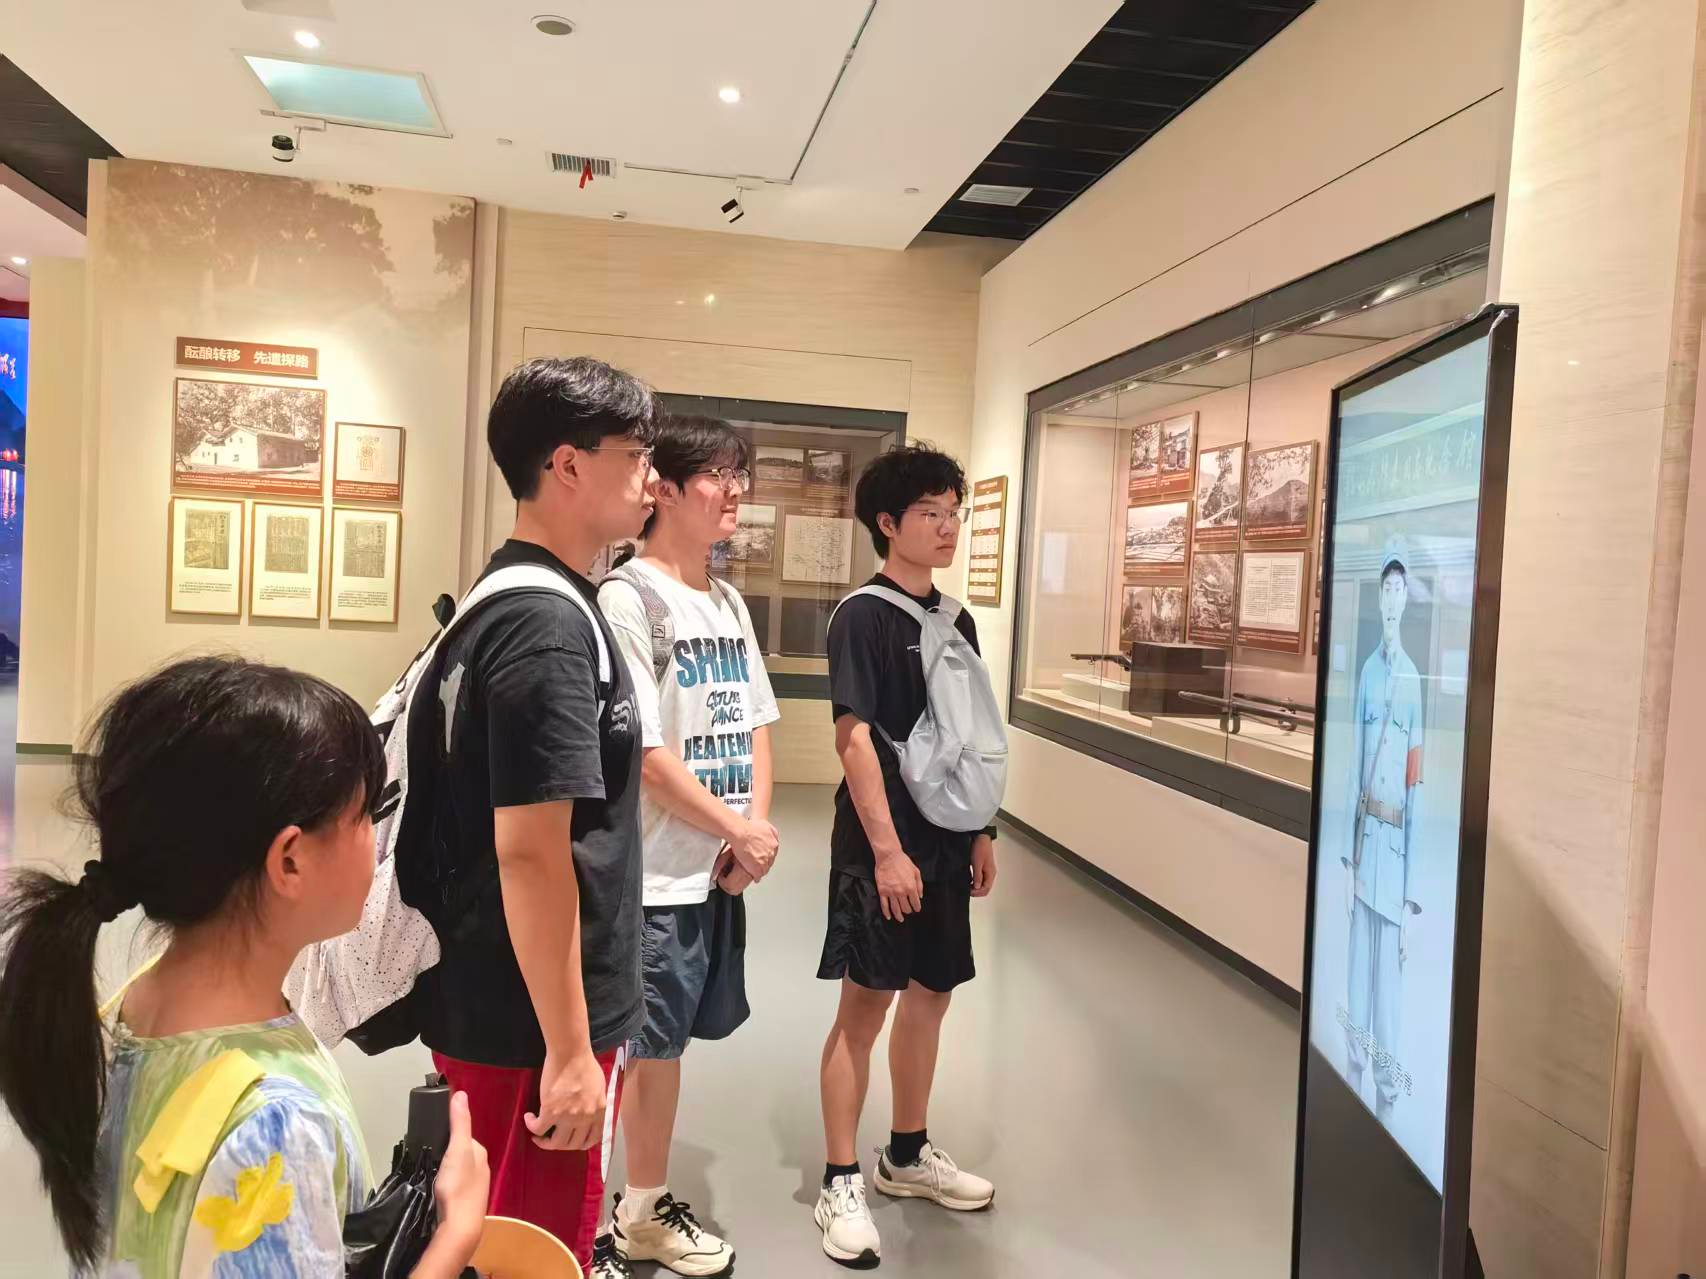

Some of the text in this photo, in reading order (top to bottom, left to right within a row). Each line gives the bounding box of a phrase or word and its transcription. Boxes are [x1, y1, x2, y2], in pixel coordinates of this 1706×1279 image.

[184, 345, 309, 369] 酝酿转移 先遣探路
